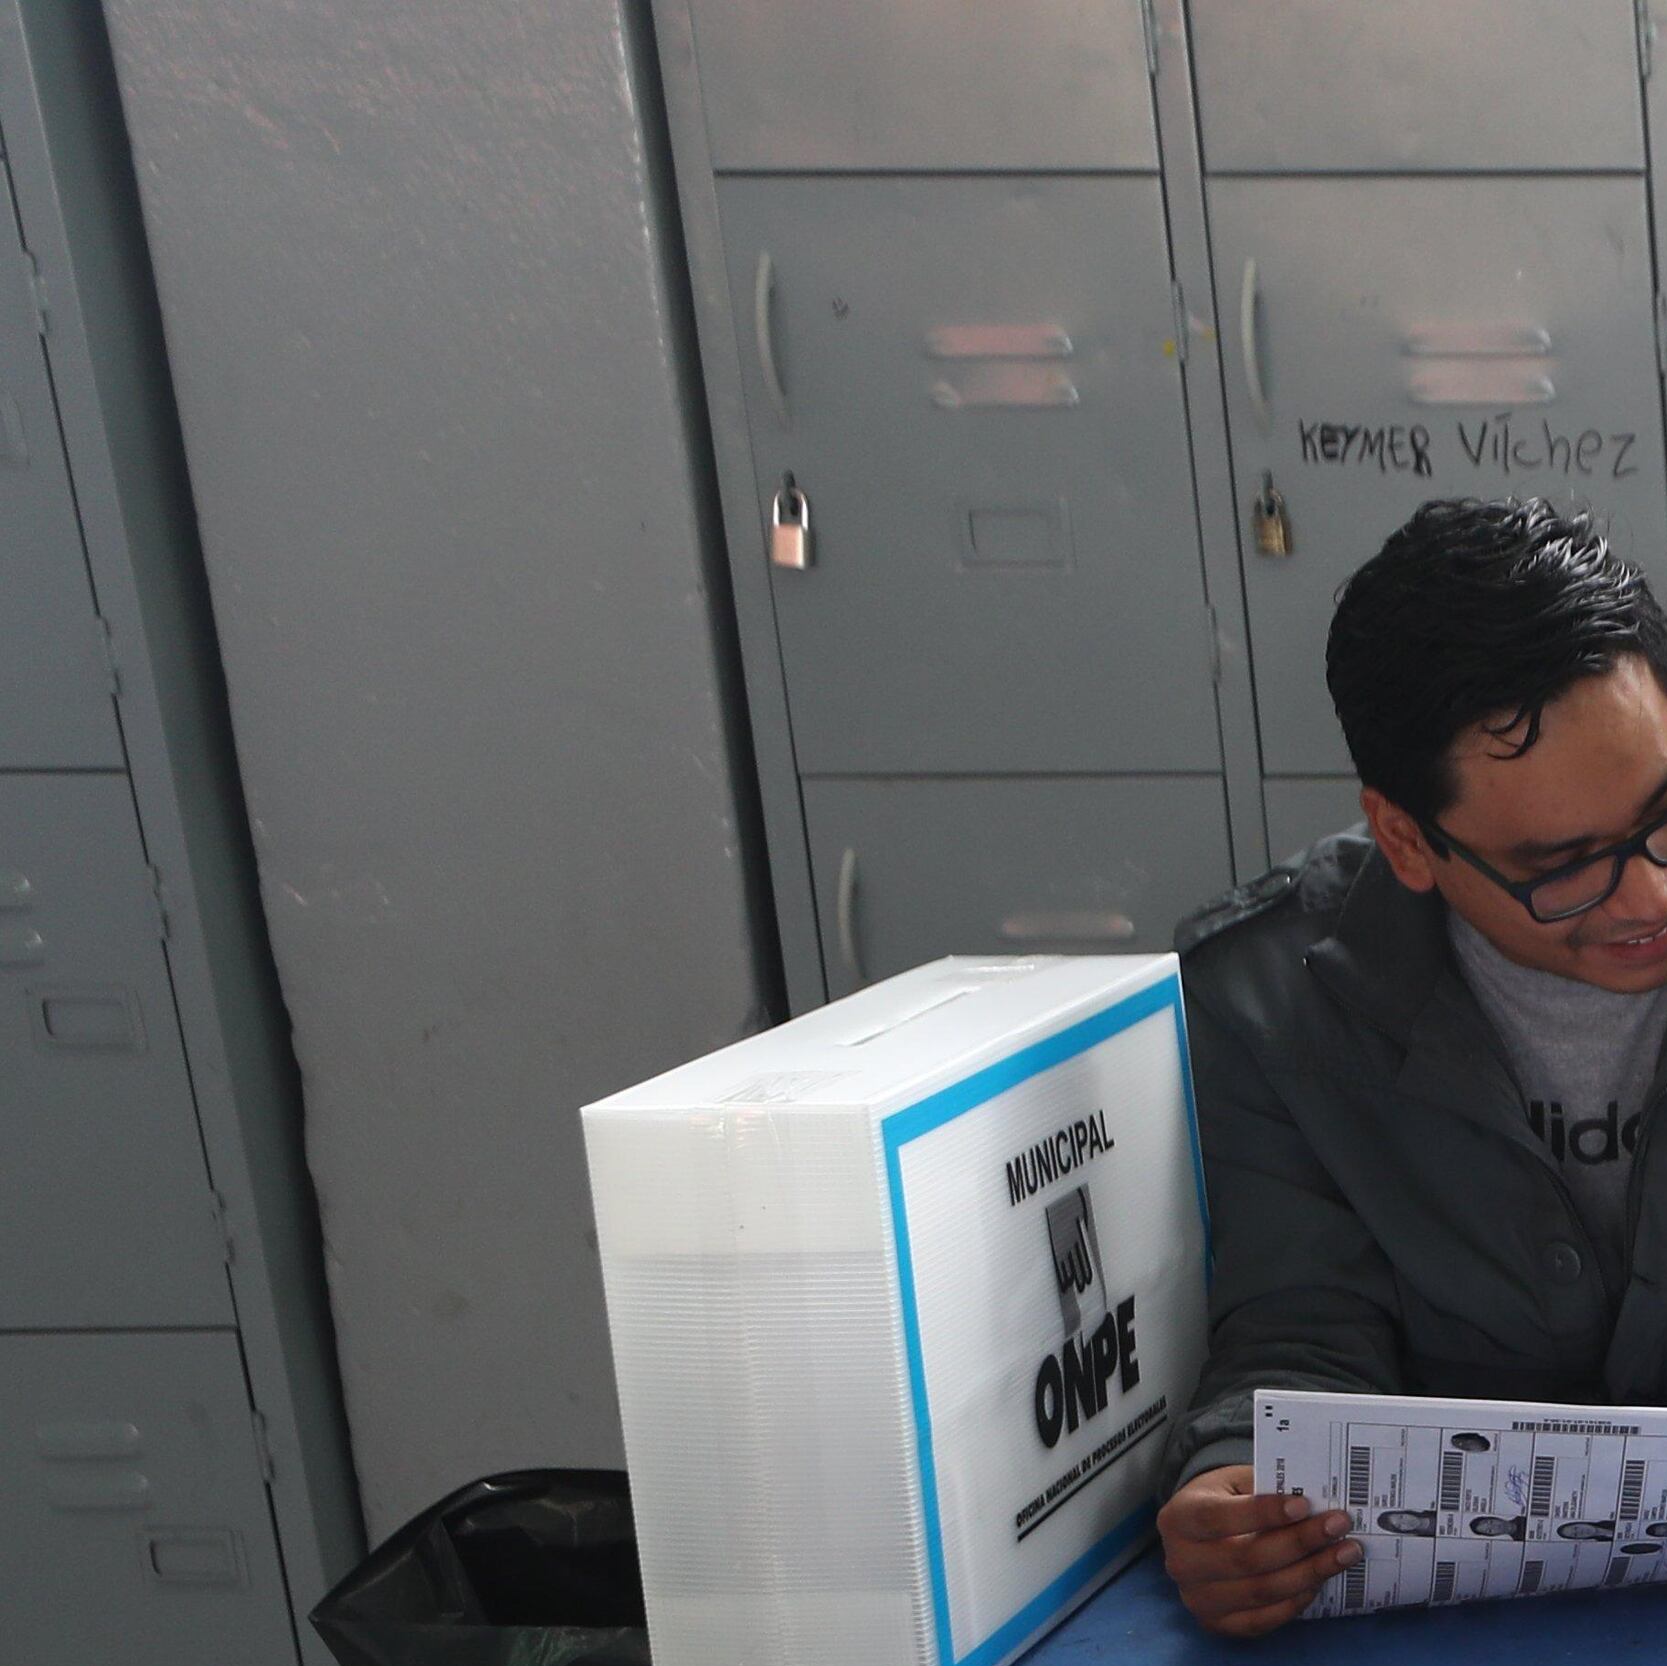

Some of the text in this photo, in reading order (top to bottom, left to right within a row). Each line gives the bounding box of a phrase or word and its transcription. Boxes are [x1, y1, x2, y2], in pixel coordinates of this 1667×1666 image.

[1004, 1108, 1115, 1207] MUNICIPAL
[1034, 1295, 1140, 1450] ONPE
[1016, 1395, 1167, 1528] OFICINA NACIONAL DE PROCESOS ELECTORALES
